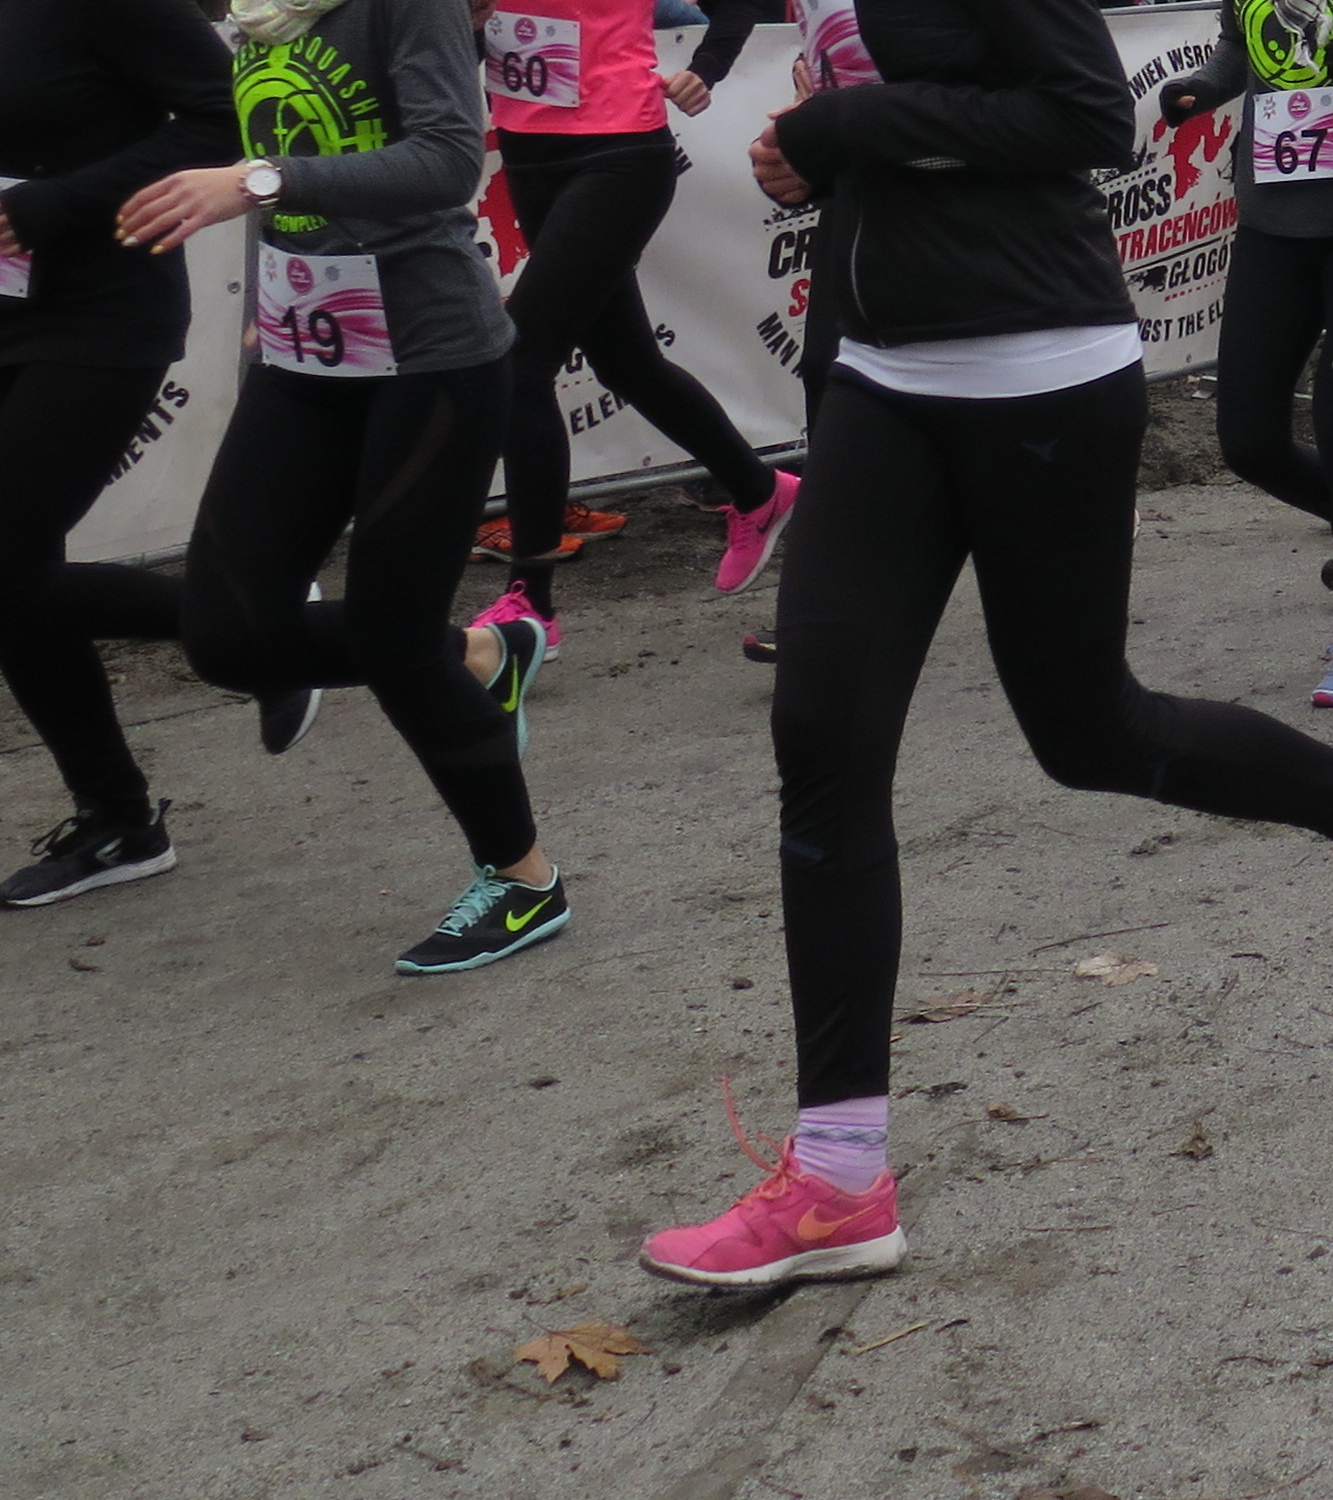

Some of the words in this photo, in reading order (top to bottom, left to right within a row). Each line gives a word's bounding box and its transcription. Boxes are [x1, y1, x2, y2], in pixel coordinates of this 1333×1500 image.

[503, 51, 548, 97] 60
[1129, 55, 1168, 100] WIEK
[1167, 39, 1215, 73] WŚRÓ
[1274, 128, 1329, 175] 67
[1107, 173, 1172, 230] ROSS
[1115, 192, 1238, 265] TRACEŃCÓW
[1168, 237, 1233, 290] GŁOGÓ
[282, 305, 345, 368] 19
[756, 311, 799, 368] MAN
[1178, 308, 1204, 339] THE
